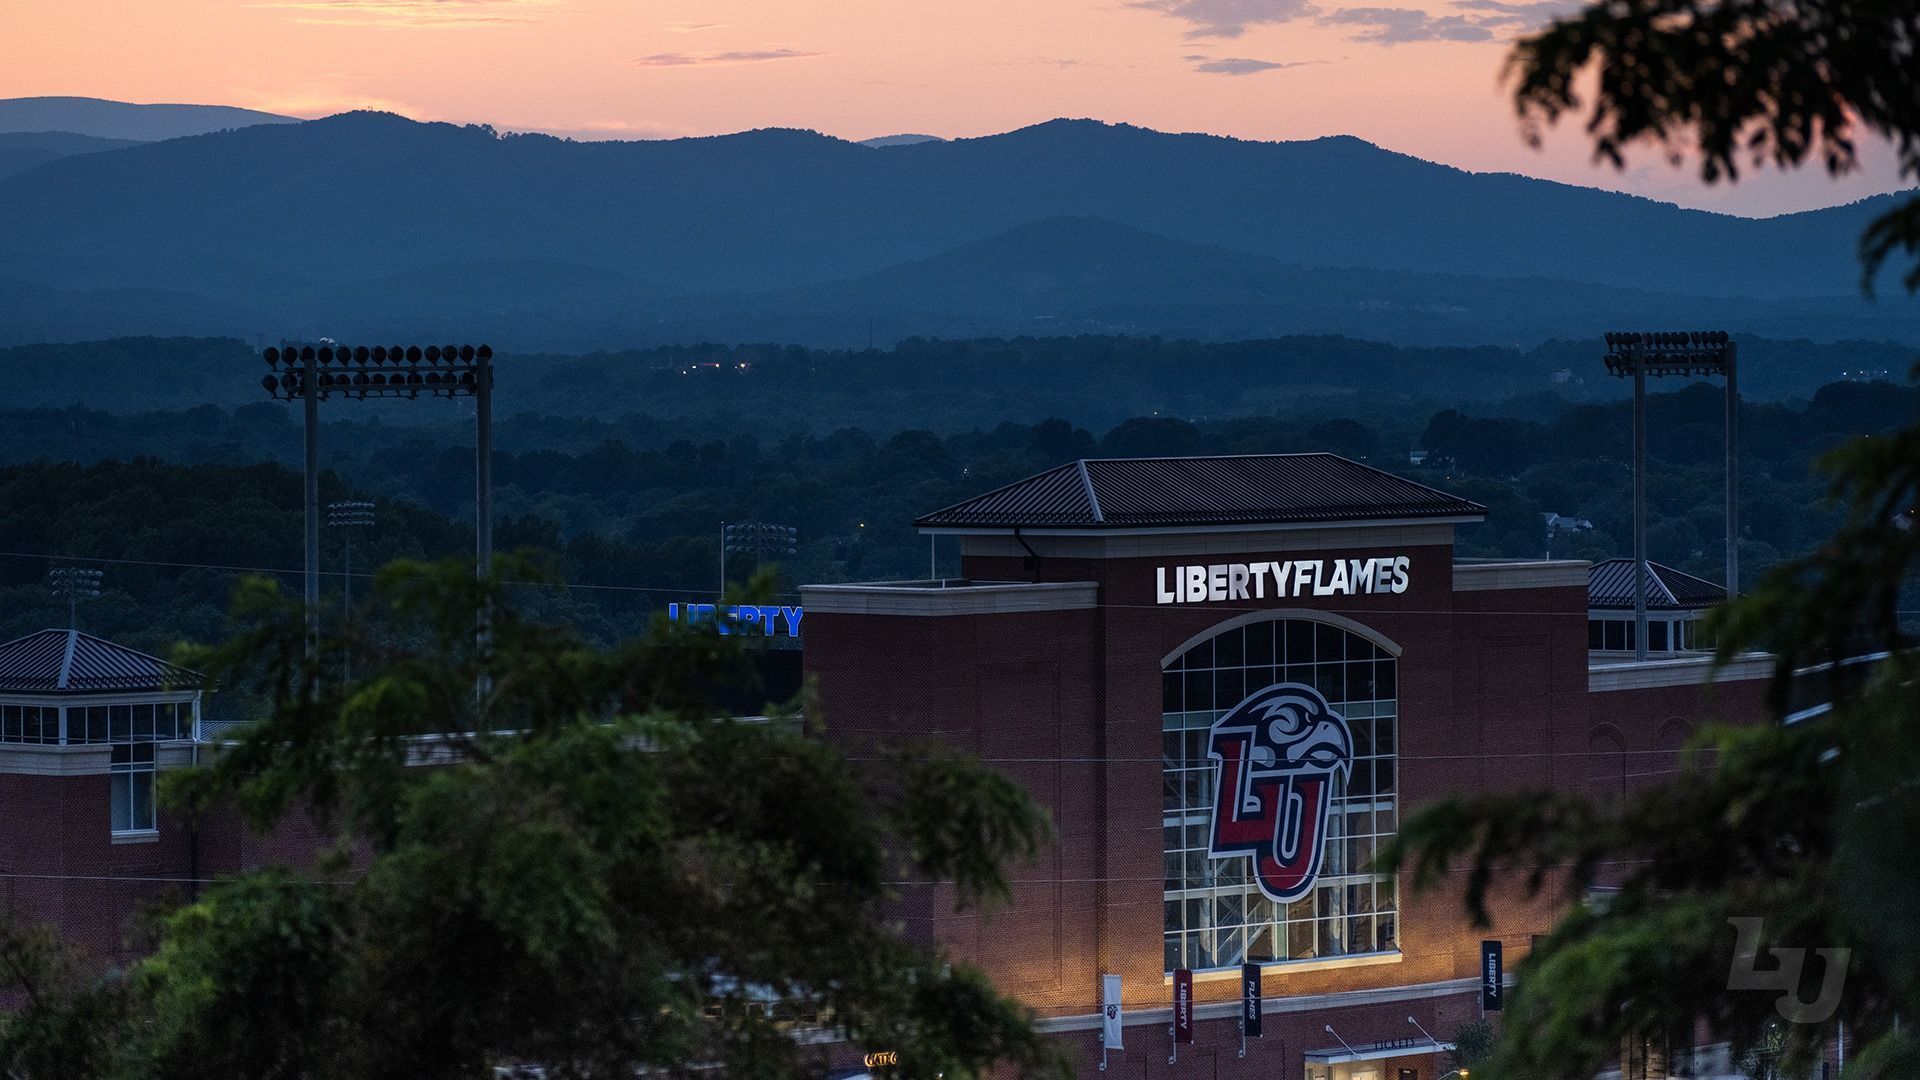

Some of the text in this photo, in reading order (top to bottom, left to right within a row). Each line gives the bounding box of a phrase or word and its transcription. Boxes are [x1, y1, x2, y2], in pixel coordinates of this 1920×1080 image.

[1488, 952, 1497, 998] LIBERTY
[1180, 982, 1188, 1030] LIBERTY
[1248, 980, 1256, 1021] FLAMES
[1373, 1036, 1415, 1051] TICKETS
